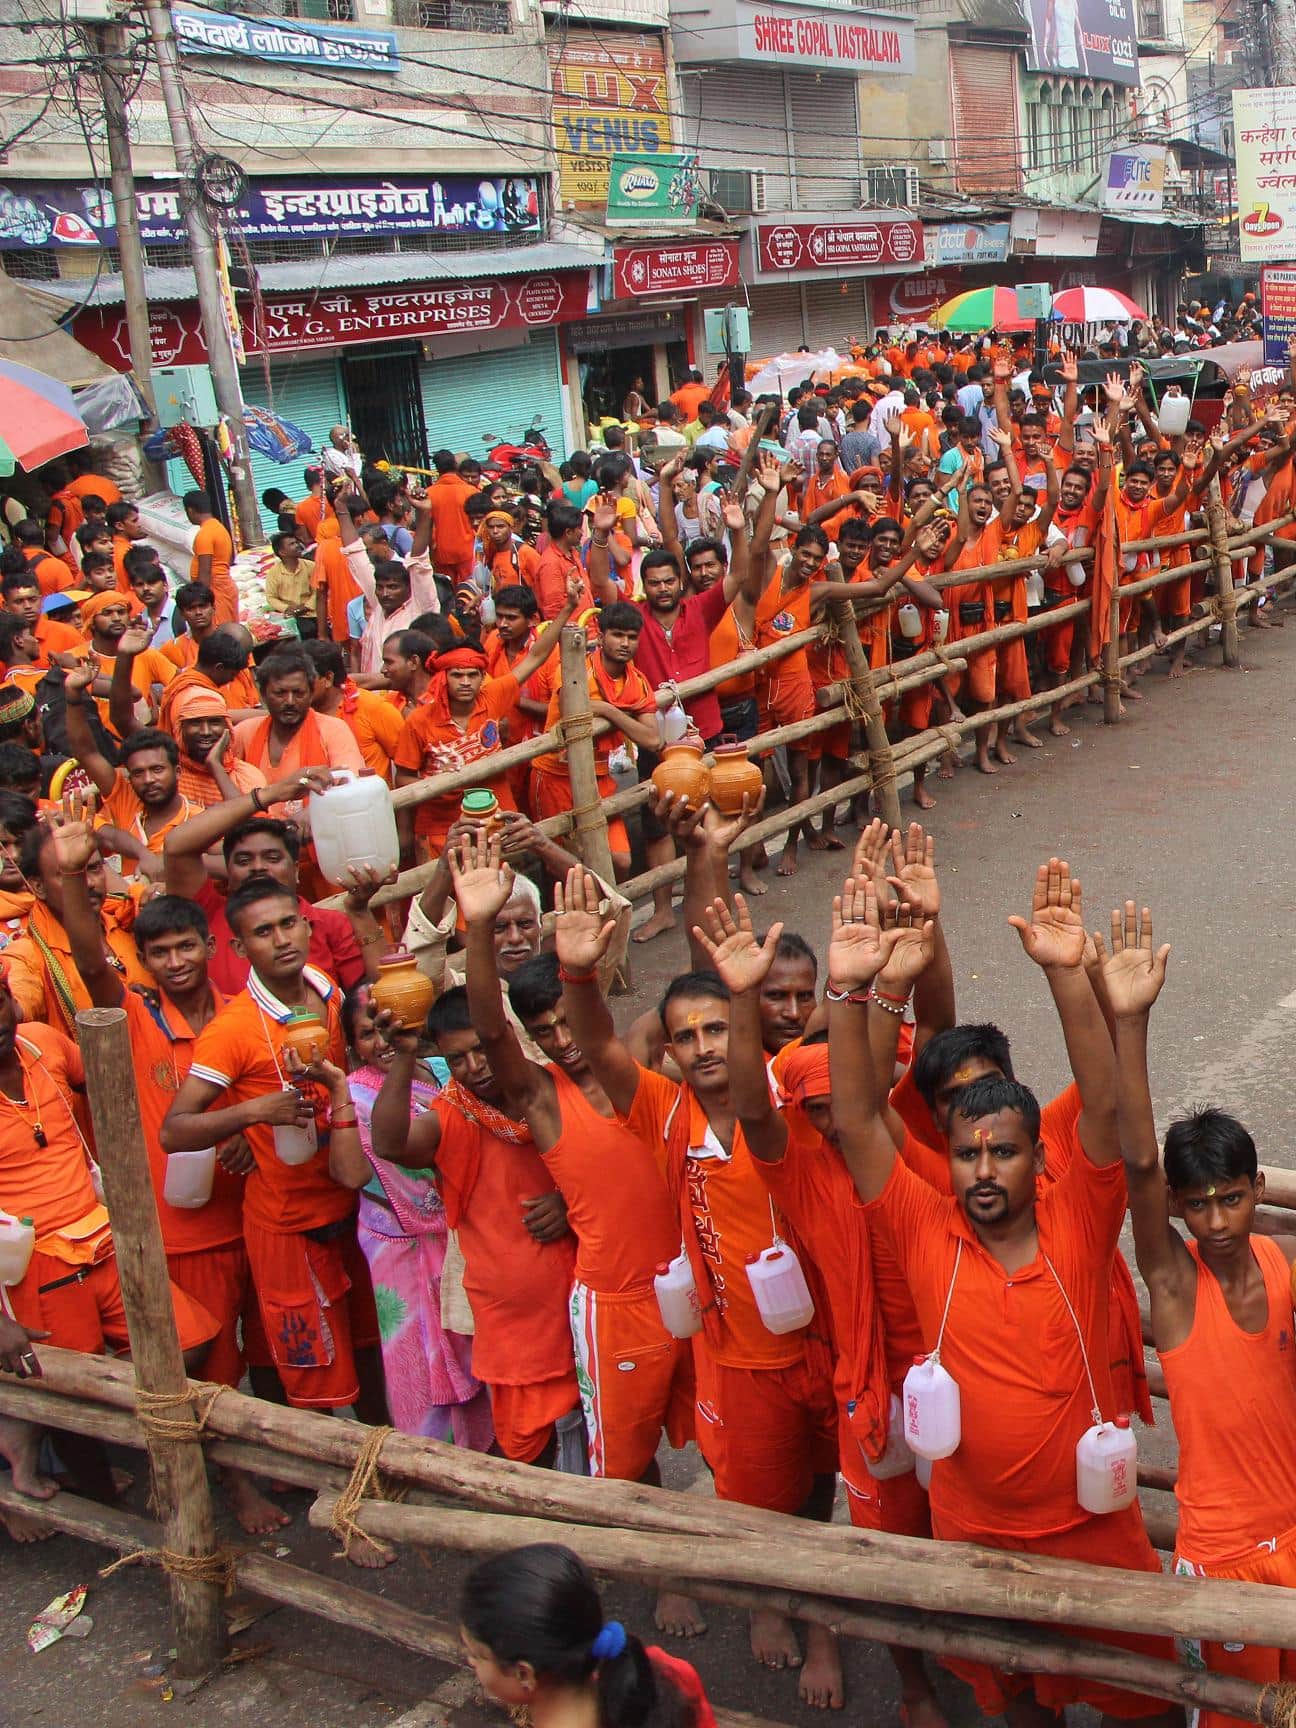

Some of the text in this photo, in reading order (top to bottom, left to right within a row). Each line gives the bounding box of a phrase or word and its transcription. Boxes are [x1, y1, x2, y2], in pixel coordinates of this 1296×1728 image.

[754, 15, 901, 63] SHREE GOPAL VASTRALAYA
[550, 69, 663, 112] LUX
[562, 116, 660, 152] VENUS
[1252, 201, 1270, 233] 7
[652, 263, 706, 279] SONATA SHOES
[1273, 272, 1280, 281] NO
[904, 279, 947, 297] RUPA
[266, 324, 297, 339] M.
[305, 320, 331, 335] G.
[338, 304, 491, 331] ENTERPRISES
[267, 302, 311, 322] एम.
[320, 295, 357, 316] जी.
